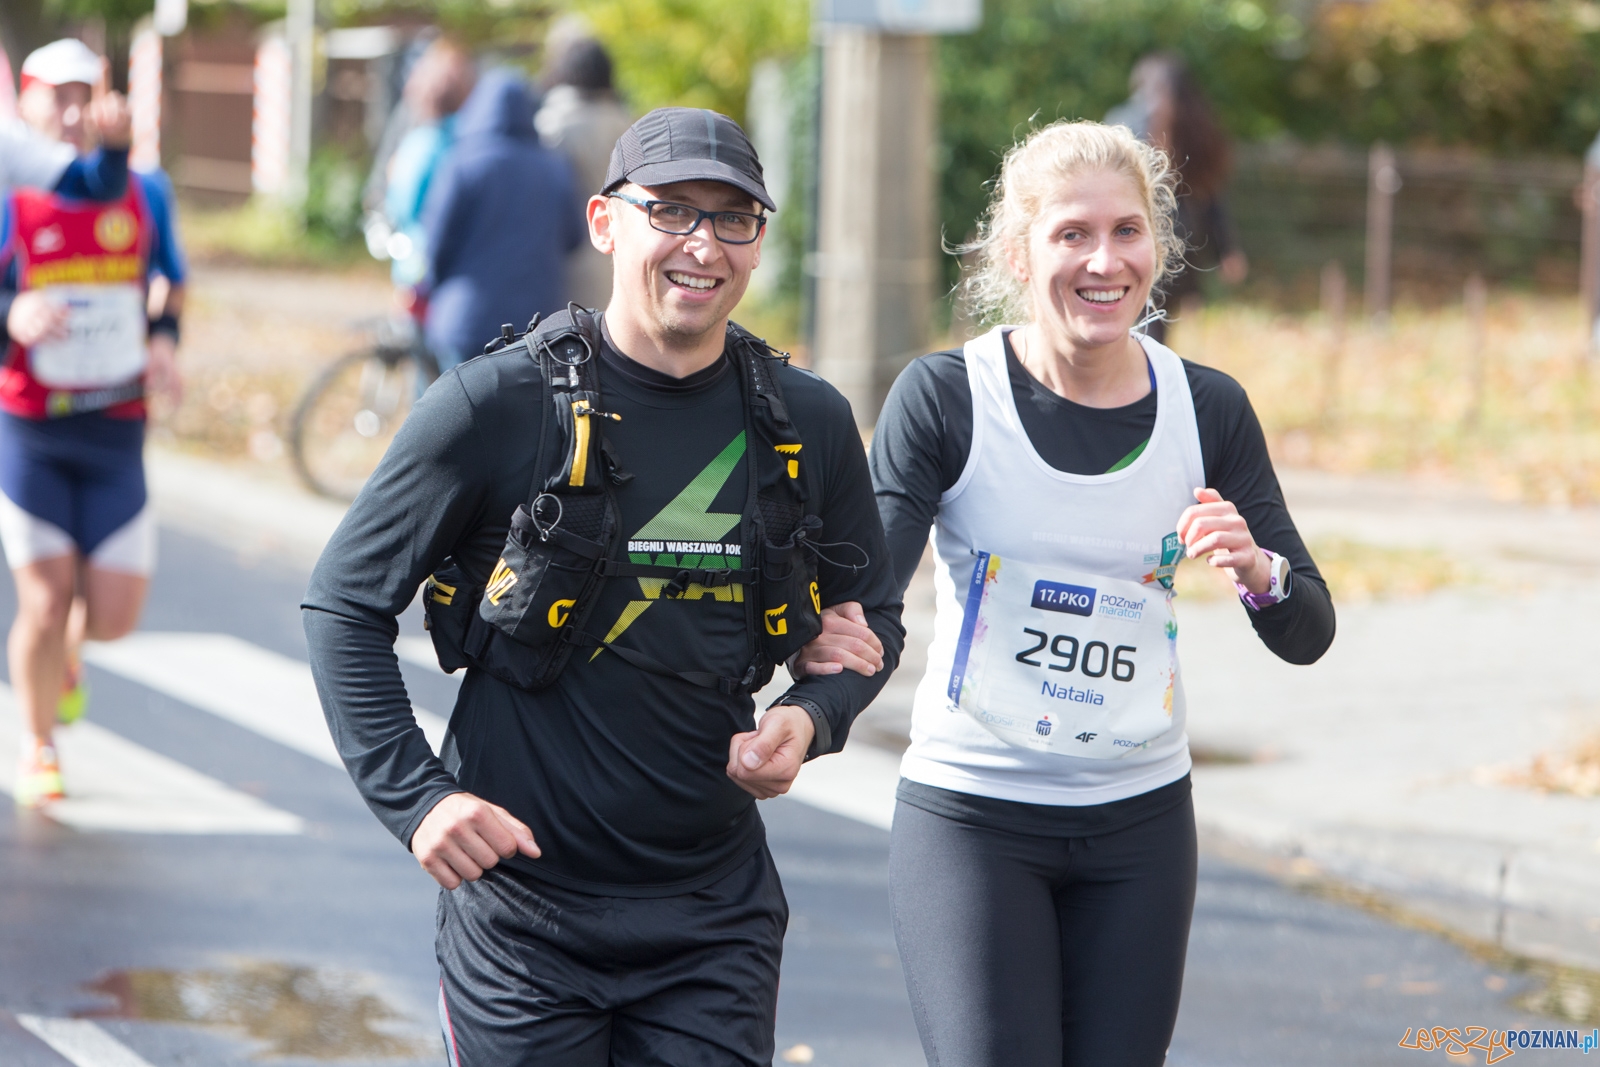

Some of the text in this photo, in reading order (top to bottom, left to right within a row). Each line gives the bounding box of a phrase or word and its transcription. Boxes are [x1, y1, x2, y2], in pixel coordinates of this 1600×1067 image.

[666, 541, 723, 553] WARSZAWO
[1068, 534, 1123, 550] WARSZAWO
[1098, 604, 1141, 620] maraton
[1015, 626, 1137, 682] 2906
[1041, 680, 1105, 706] Natalia
[1075, 731, 1098, 744] 4F
